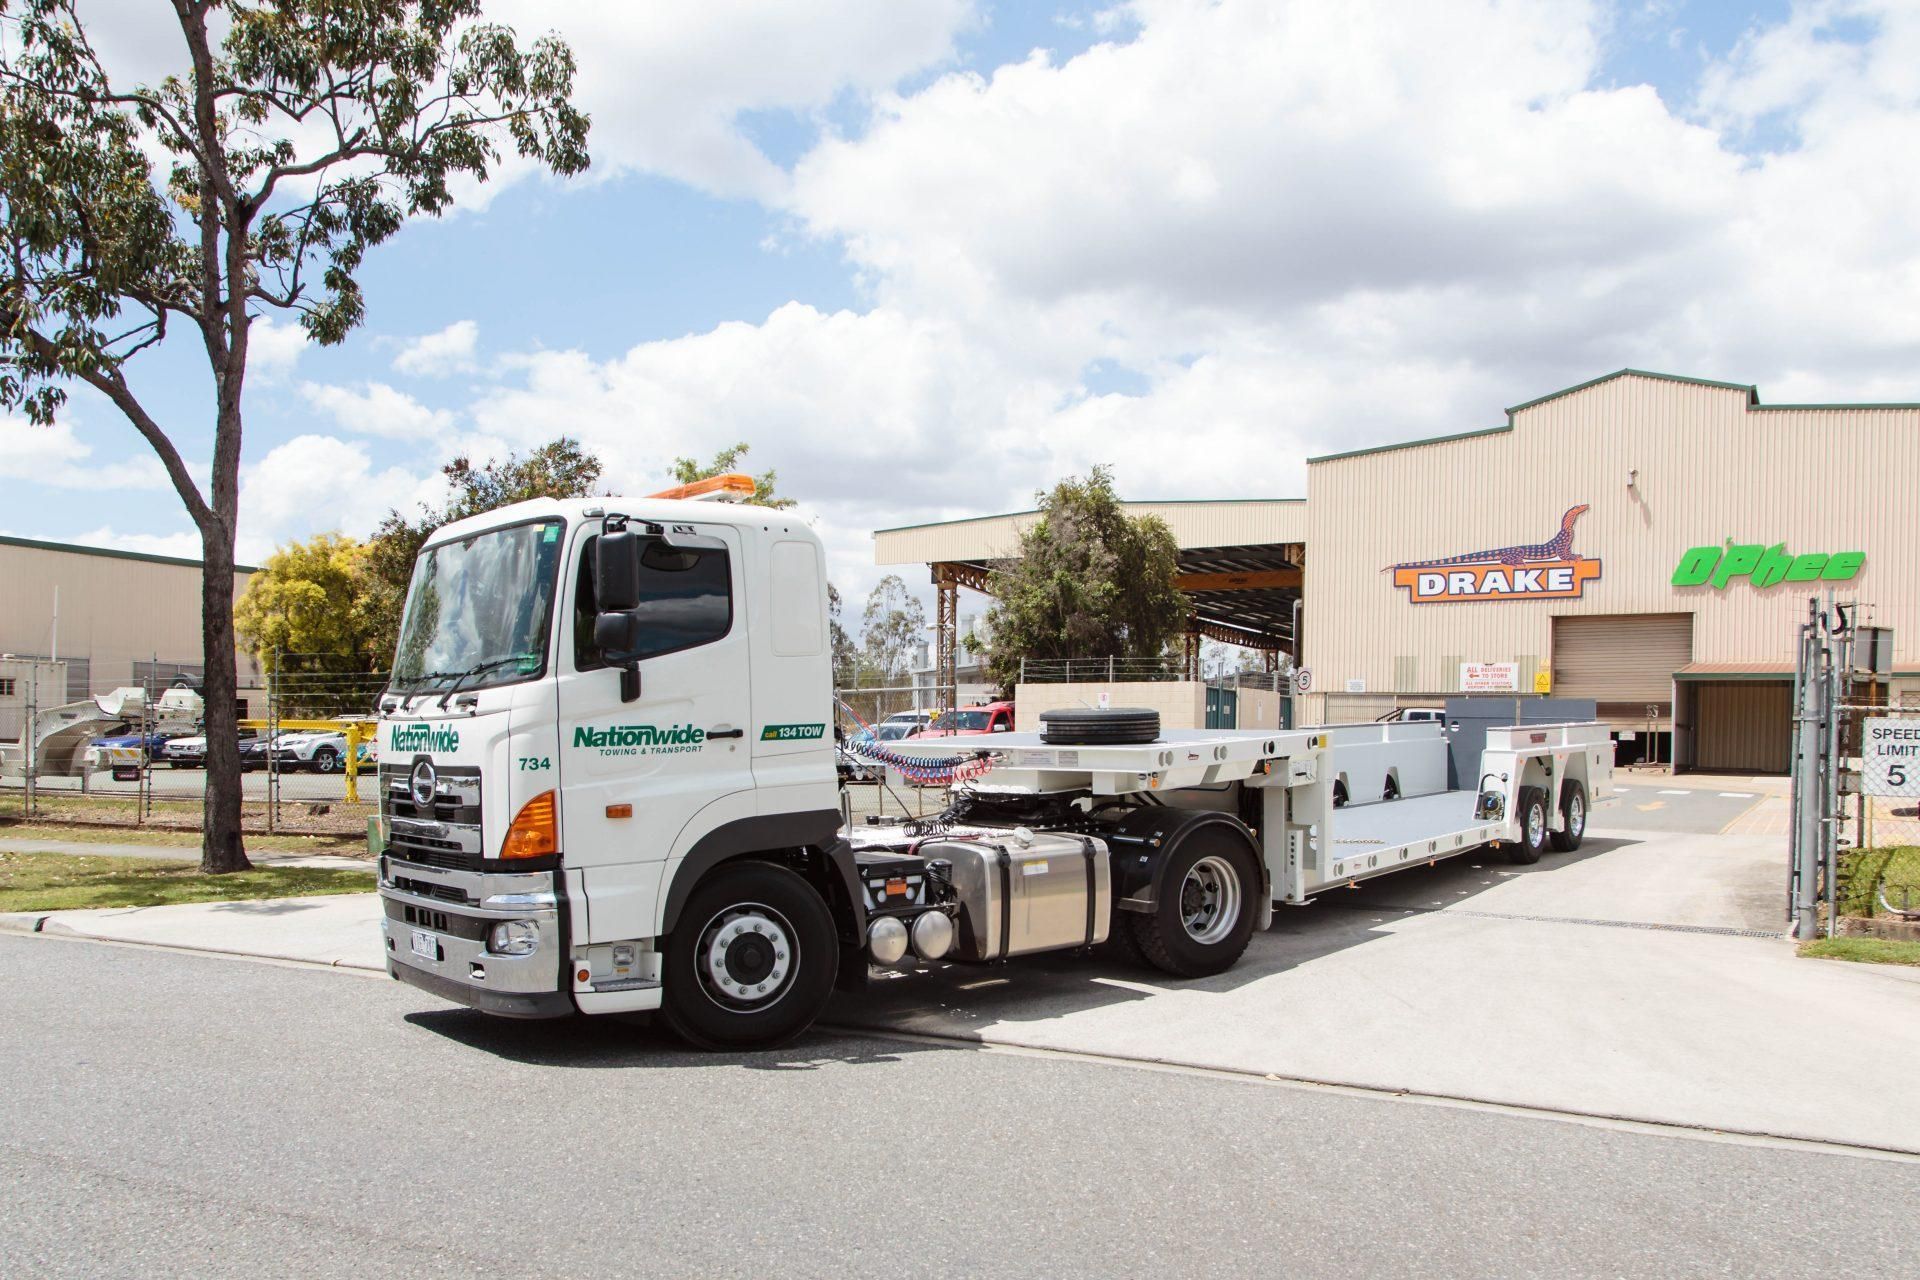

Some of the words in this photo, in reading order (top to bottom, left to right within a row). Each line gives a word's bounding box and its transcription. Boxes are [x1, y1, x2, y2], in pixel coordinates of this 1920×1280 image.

[1417, 567, 1575, 597] DRAKE
[1302, 675, 1308, 686] 5
[391, 724, 459, 752] Nationwide
[573, 724, 705, 748] Nationwide
[600, 748, 637, 756] TOWING
[651, 745, 703, 755] TRANSPORT
[1877, 744, 1919, 756] LIMIT
[519, 757, 551, 771] 734
[1887, 765, 1906, 786] 5
